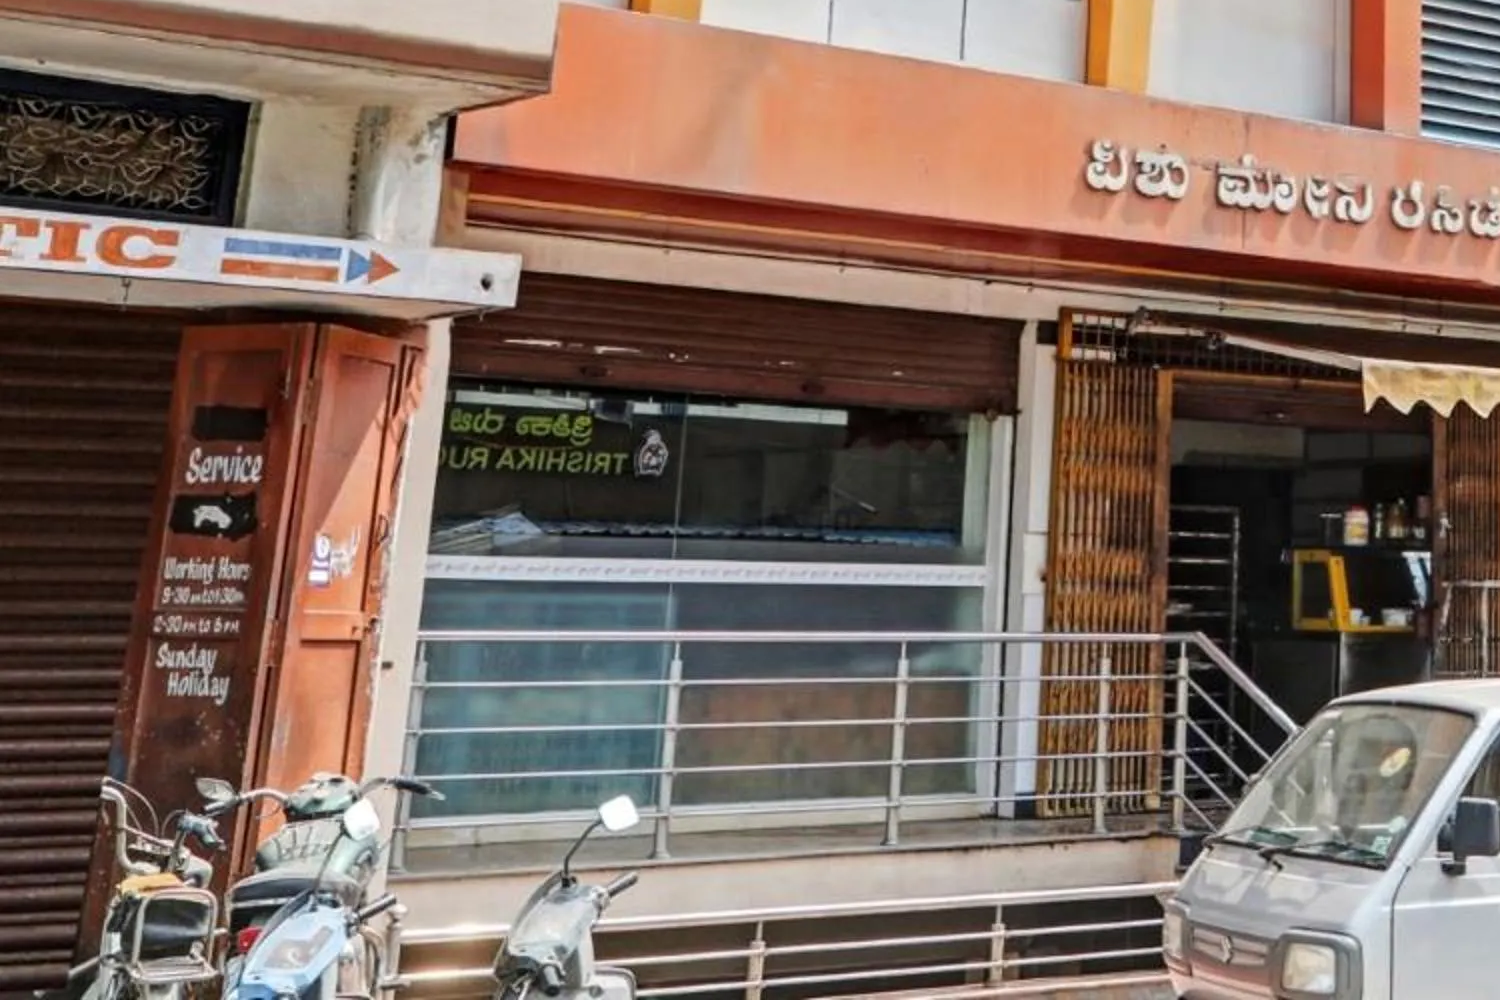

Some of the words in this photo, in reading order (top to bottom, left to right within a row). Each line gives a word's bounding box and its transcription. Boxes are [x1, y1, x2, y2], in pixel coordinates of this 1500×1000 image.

[185, 446, 264, 484] Service
[163, 556, 216, 585] Working
[217, 556, 252, 582] Hours
[155, 642, 218, 675] Sunday
[167, 671, 231, 706] Holiday
